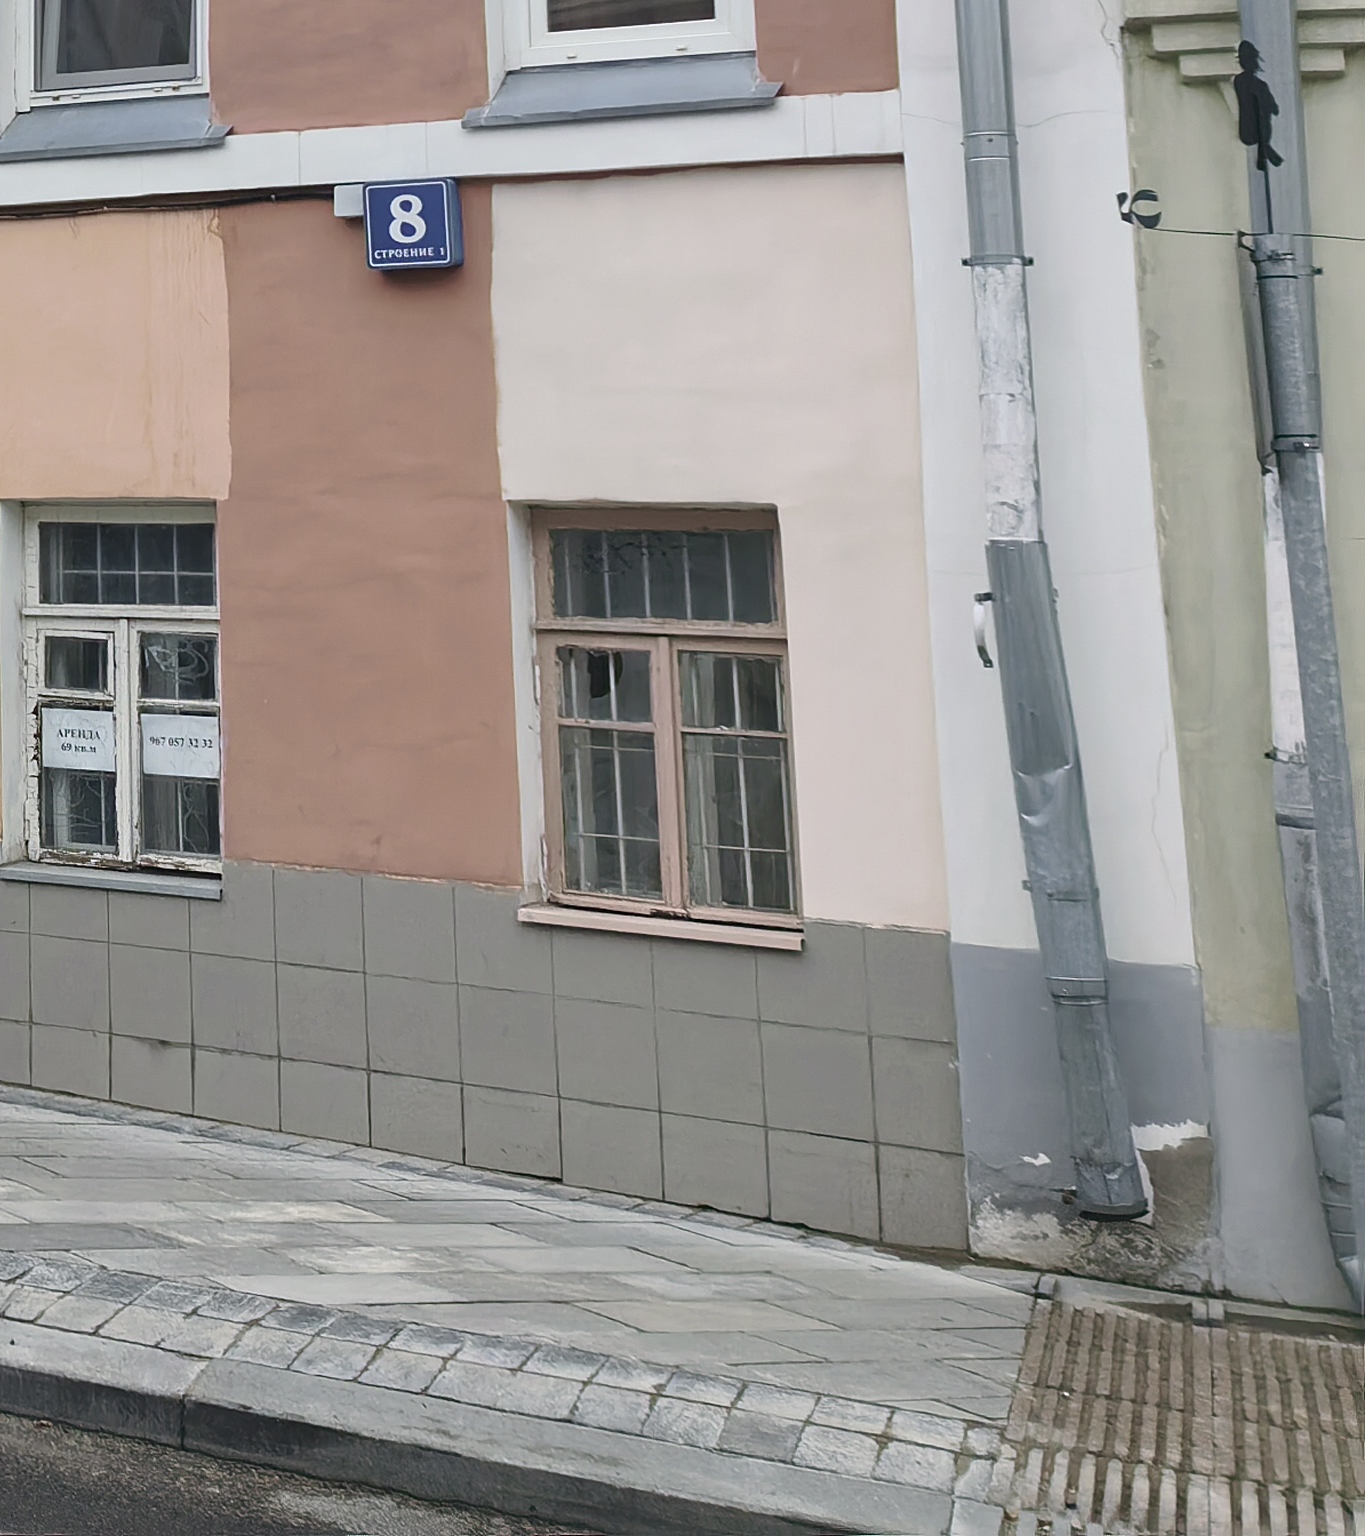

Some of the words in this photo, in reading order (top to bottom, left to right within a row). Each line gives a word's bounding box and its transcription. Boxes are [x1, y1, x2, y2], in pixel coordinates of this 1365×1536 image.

[388, 193, 427, 244] 8
[374, 246, 434, 259] СТРОЕНИЕ
[439, 247, 445, 256] 1
[56, 728, 101, 740] АРЕНДА
